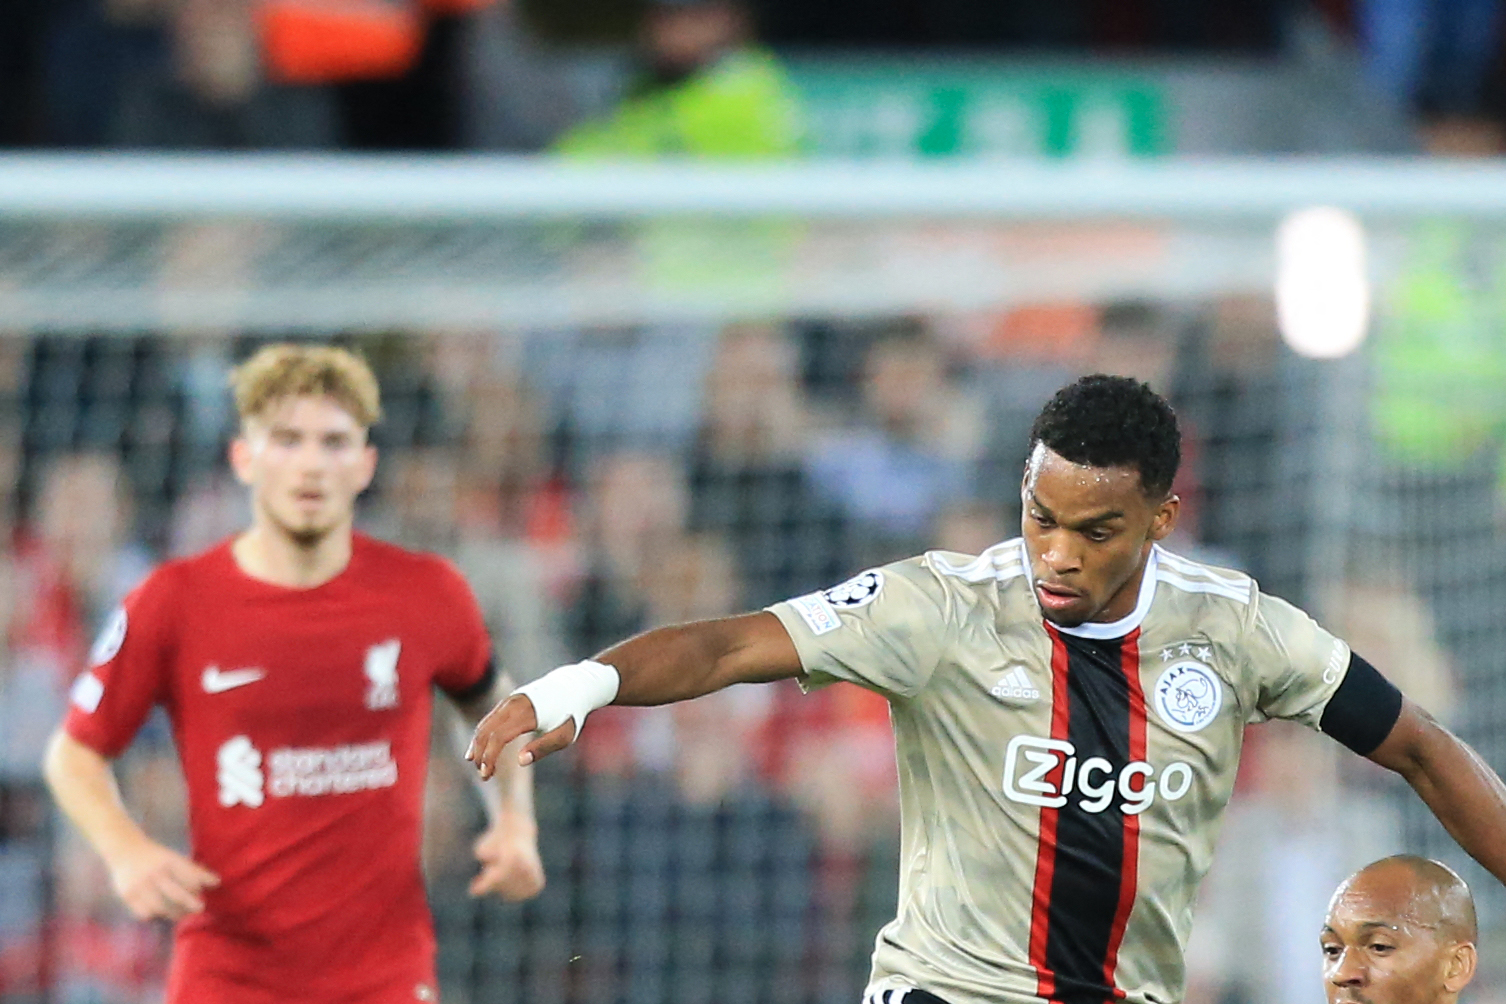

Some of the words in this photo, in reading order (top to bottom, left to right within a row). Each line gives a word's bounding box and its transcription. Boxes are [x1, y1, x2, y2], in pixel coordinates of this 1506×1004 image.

[991, 685, 1040, 699] adidas
[1160, 667, 1185, 695] AJAX
[1003, 735, 1193, 815] Ziggo
